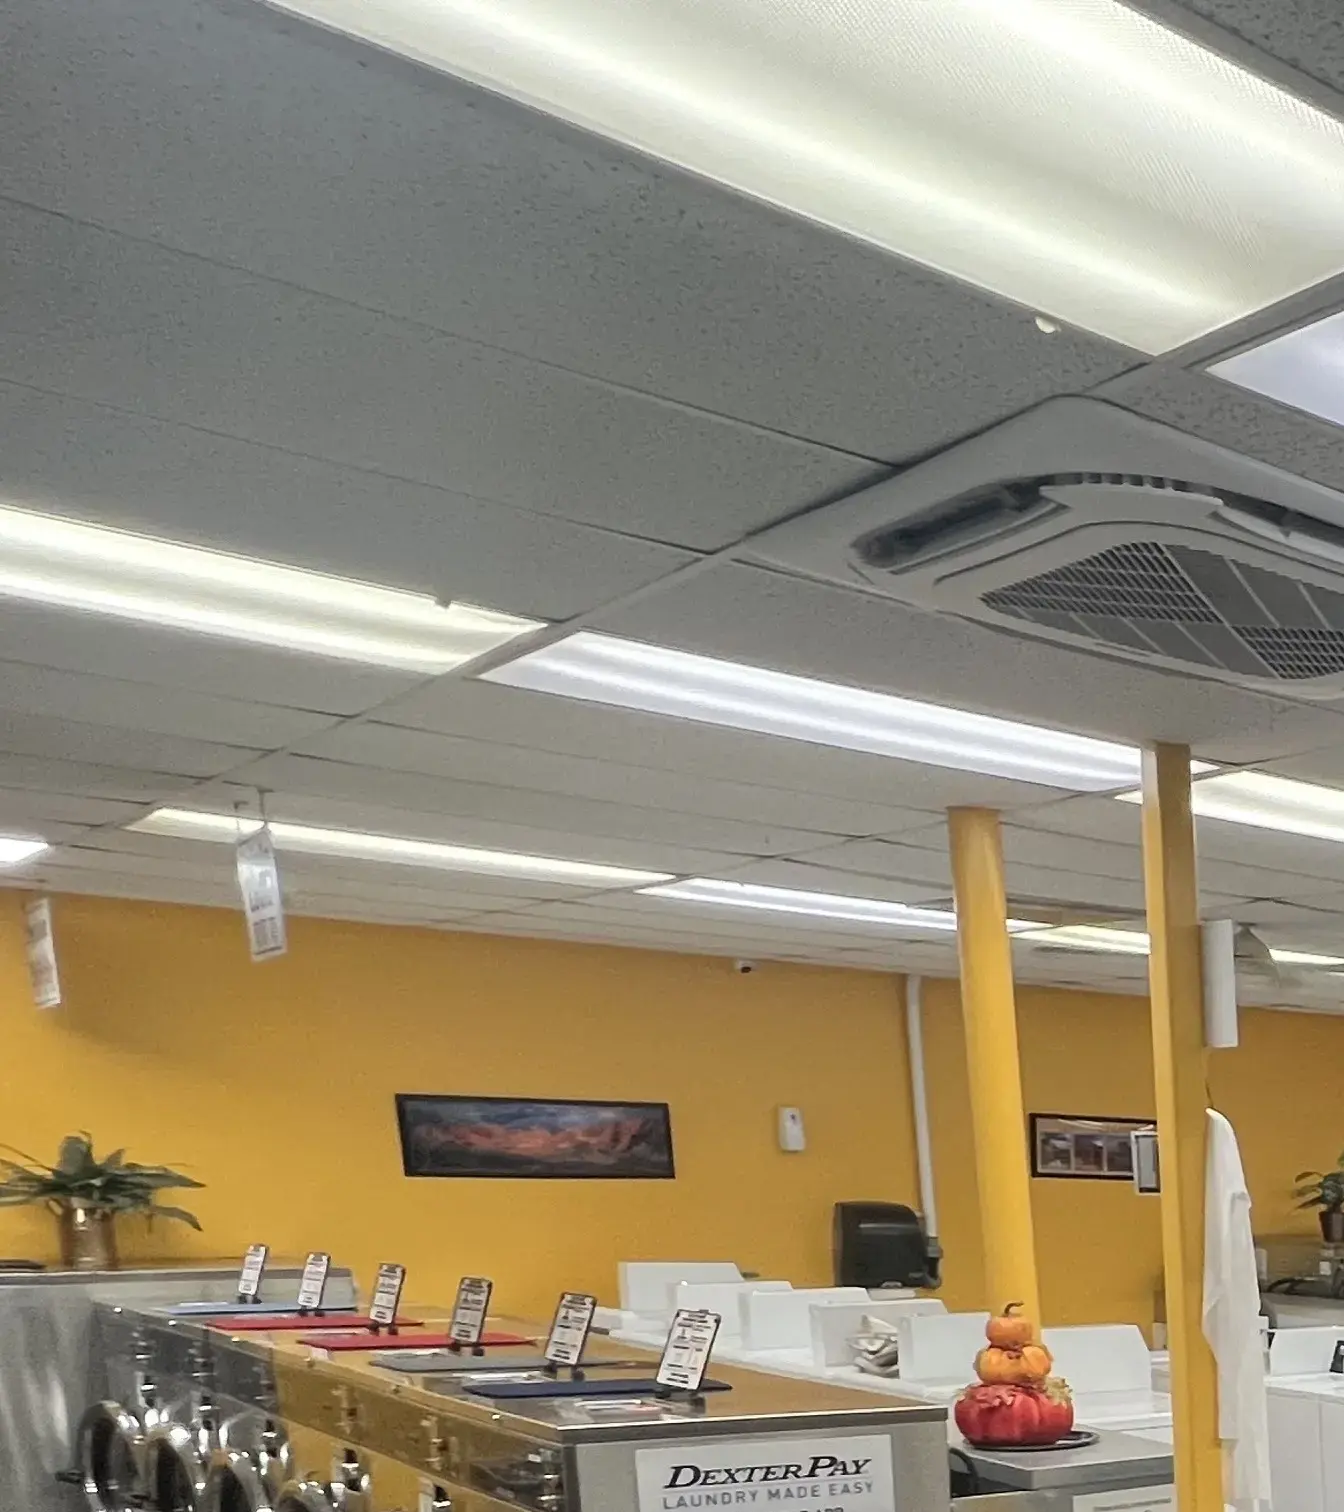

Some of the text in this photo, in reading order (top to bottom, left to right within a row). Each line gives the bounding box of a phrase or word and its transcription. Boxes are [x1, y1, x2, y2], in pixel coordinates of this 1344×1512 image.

[663, 1480, 874, 1510] LAUNDRY MADE EASY
